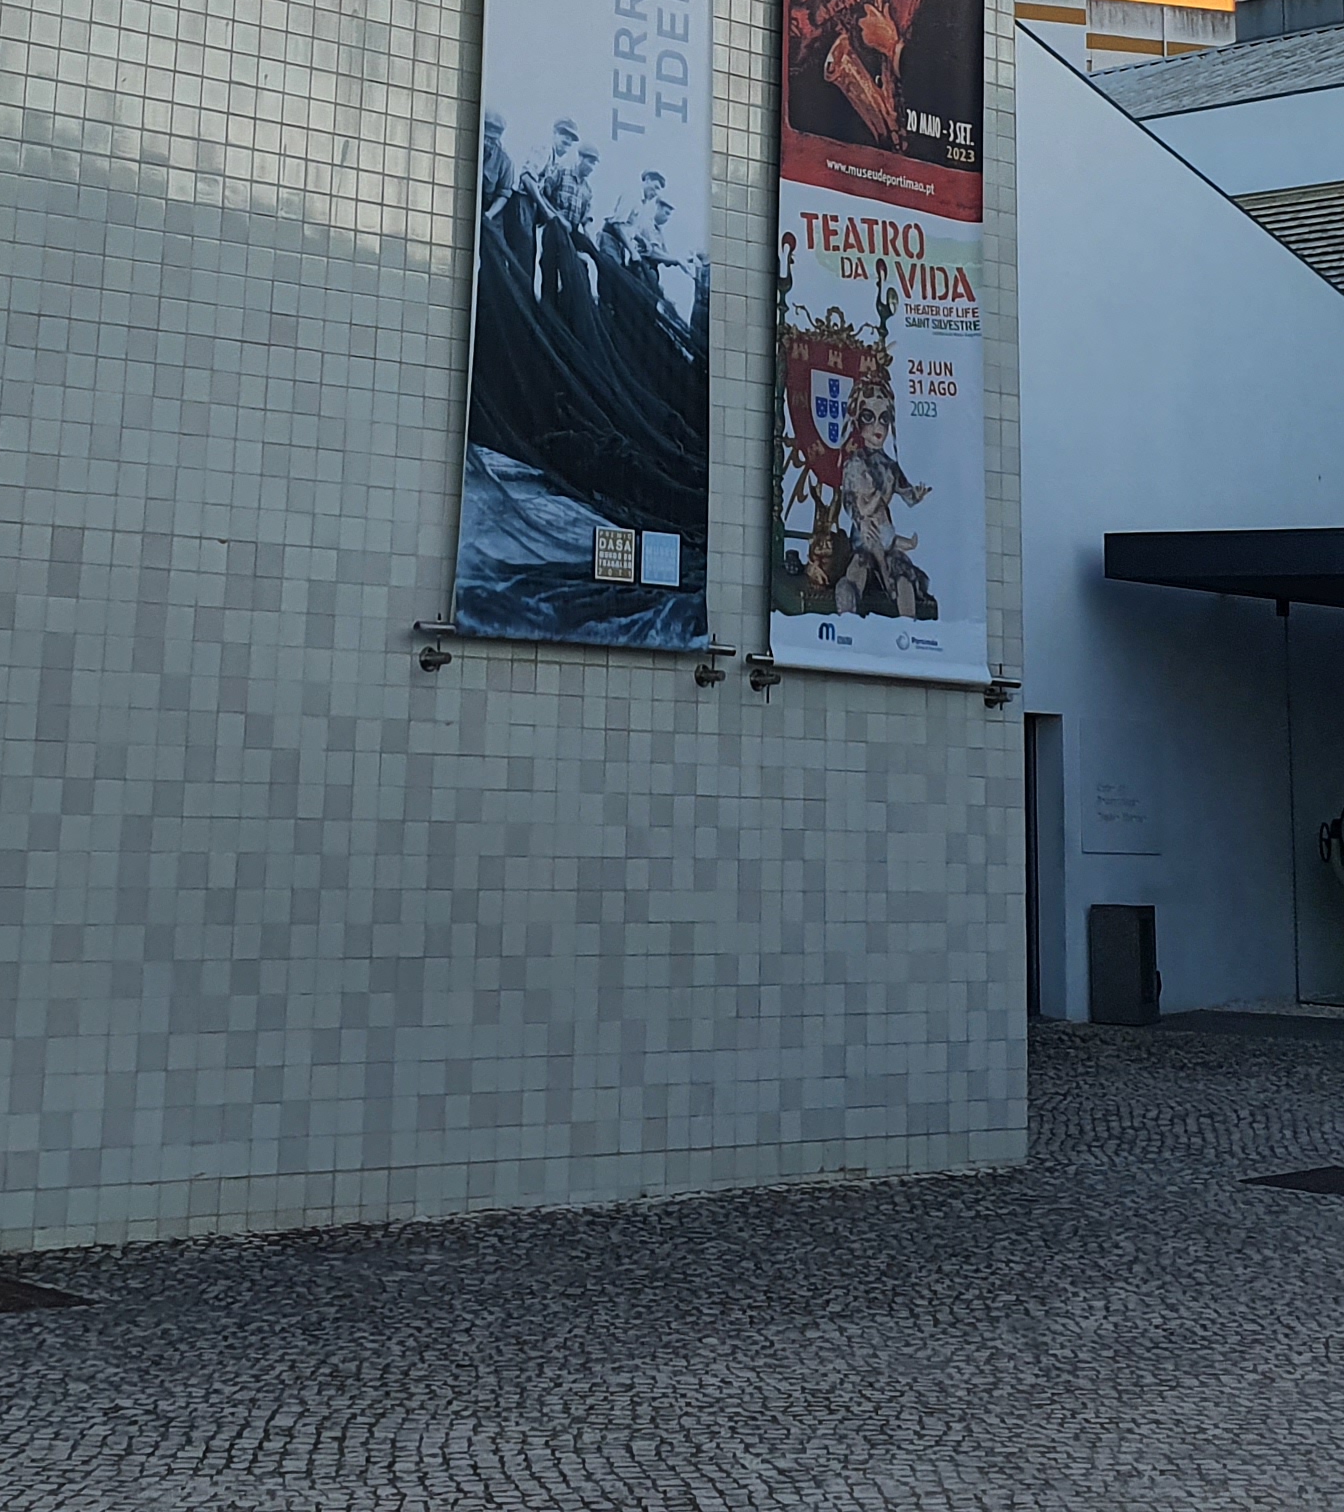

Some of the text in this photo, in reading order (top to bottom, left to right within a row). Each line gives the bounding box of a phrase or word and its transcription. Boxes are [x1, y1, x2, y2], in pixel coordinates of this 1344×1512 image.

[906, 109, 918, 132] 20
[919, 112, 941, 139] MAIO
[949, 120, 955, 142] 3
[956, 122, 975, 146] SET.
[946, 145, 975, 163] 2023
[826, 159, 936, 196] www.museudeportimao.pt
[800, 211, 926, 261] TEATRO
[840, 256, 977, 303] DA VIDA
[904, 303, 980, 319] THEATER OF LIFE
[905, 316, 981, 332] SAINT SILVESTRE
[907, 359, 953, 377] 24 JUN
[908, 378, 958, 397] 31 AGO
[909, 400, 938, 418] 2023
[599, 538, 632, 552] DASA
